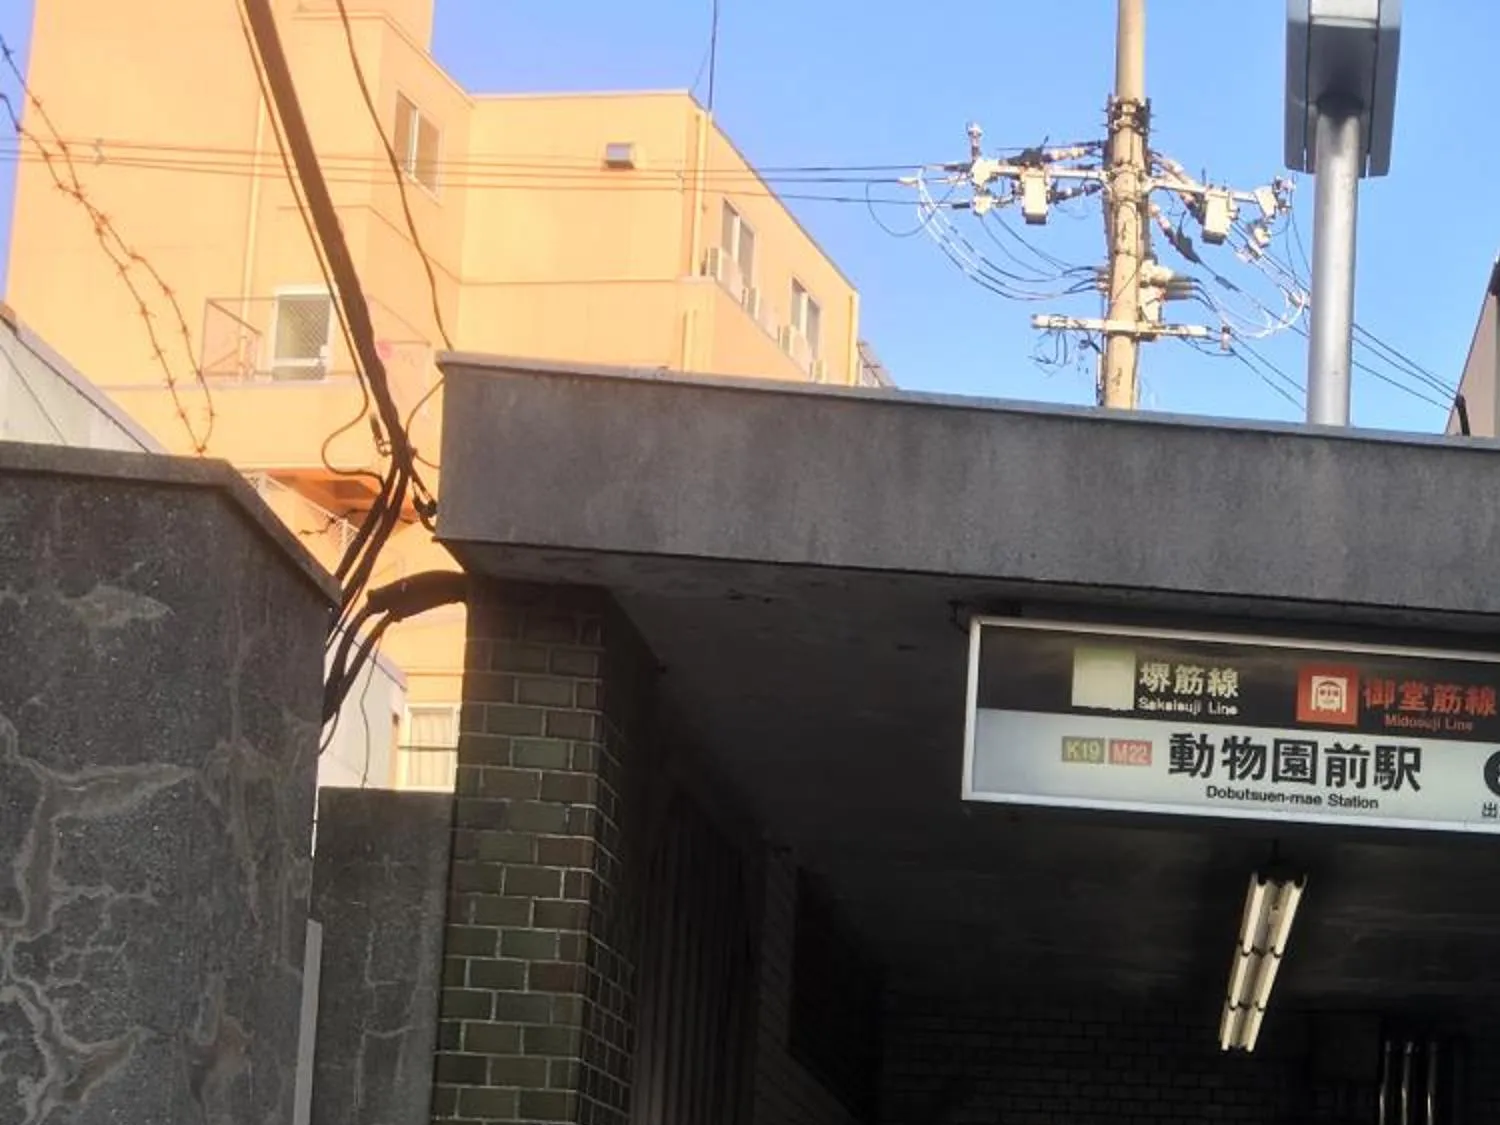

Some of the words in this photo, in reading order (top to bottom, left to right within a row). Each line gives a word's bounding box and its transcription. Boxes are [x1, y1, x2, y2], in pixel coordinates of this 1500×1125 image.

[1138, 661, 1240, 699] 堺筋線
[1136, 695, 1201, 717] Sakaisuji
[1207, 700, 1239, 717] Line
[1363, 676, 1498, 717] 御堂筋線
[1384, 713, 1442, 732] Midosuji
[1444, 716, 1474, 731] Line
[1065, 739, 1101, 763] K19
[1111, 741, 1150, 764] M22
[1167, 732, 1422, 793] 動物園前駅
[1205, 784, 1323, 806] Dobutsuen-mae
[1327, 792, 1380, 810] Station
